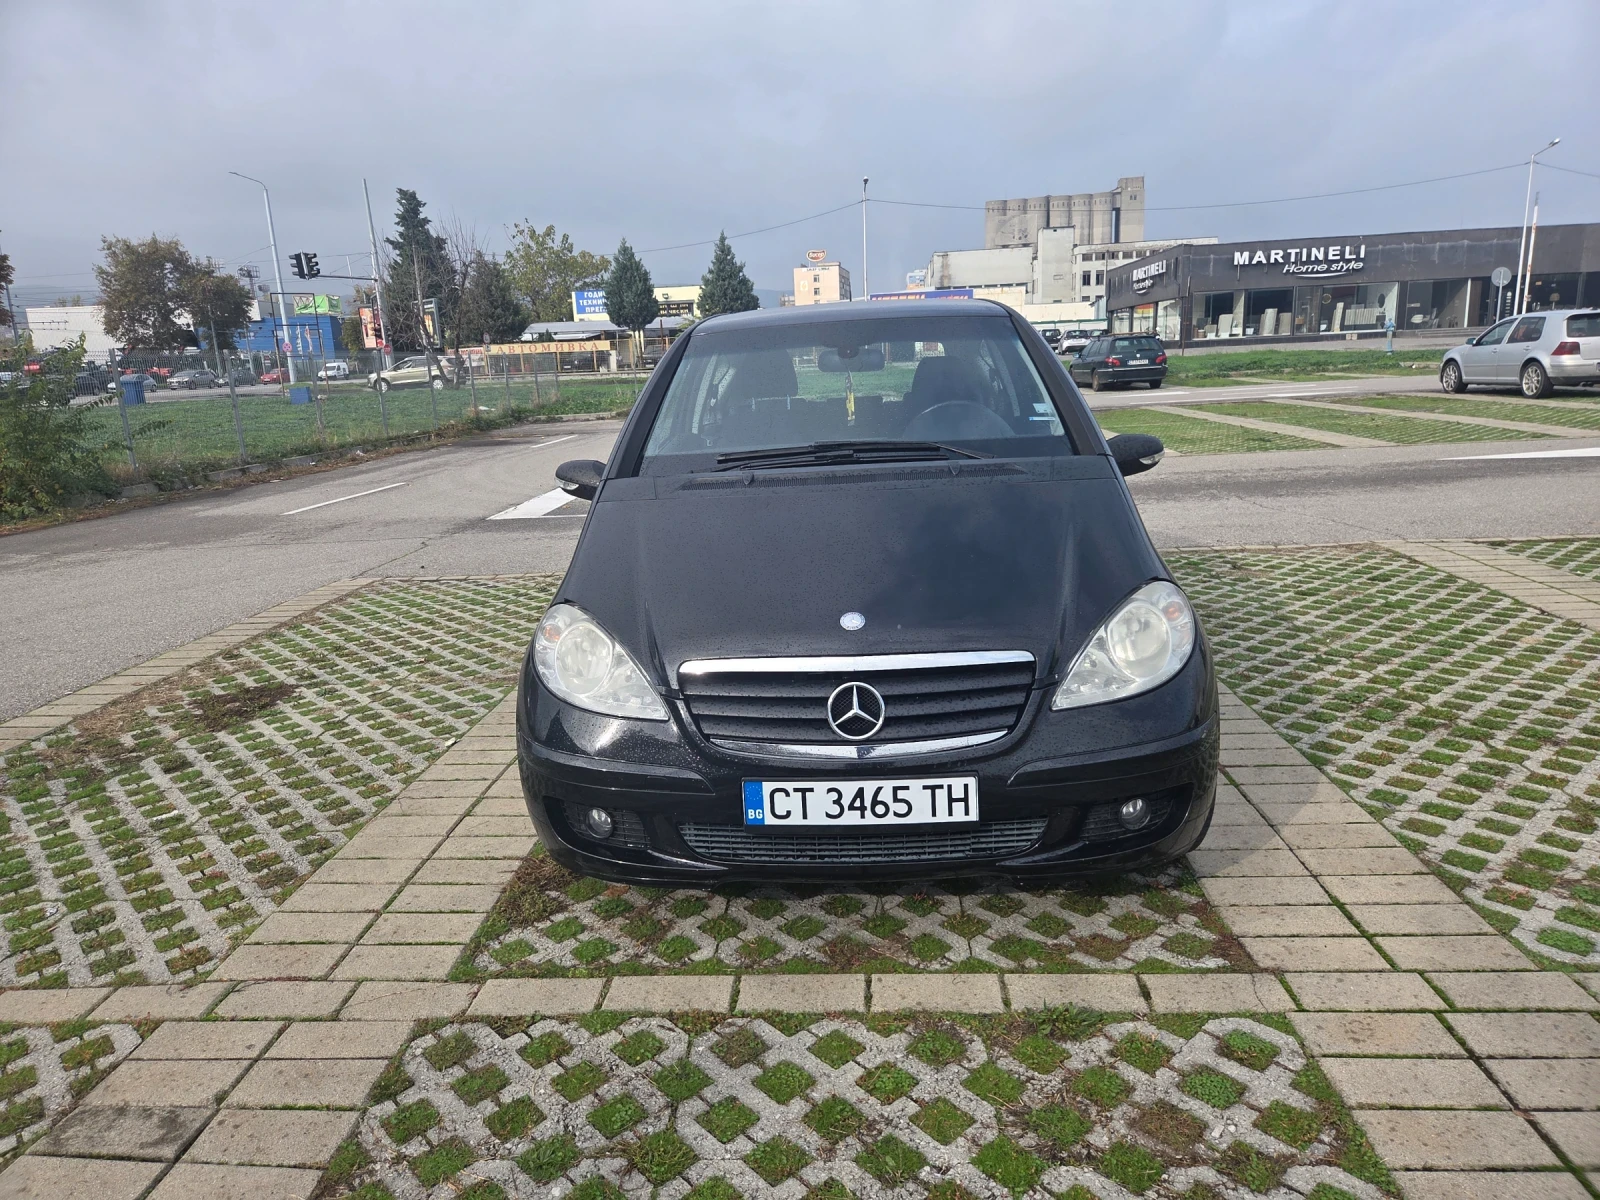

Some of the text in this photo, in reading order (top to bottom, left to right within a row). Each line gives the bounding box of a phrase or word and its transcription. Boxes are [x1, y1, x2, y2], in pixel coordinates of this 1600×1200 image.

[1233, 245, 1366, 266] MARTINELI
[1132, 260, 1167, 282] MARTINELI
[1282, 261, 1364, 273] Home style
[496, 342, 599, 354] АВТОМИВКА
[769, 783, 971, 820] CT 3465 TH
[747, 809, 763, 820] BG
